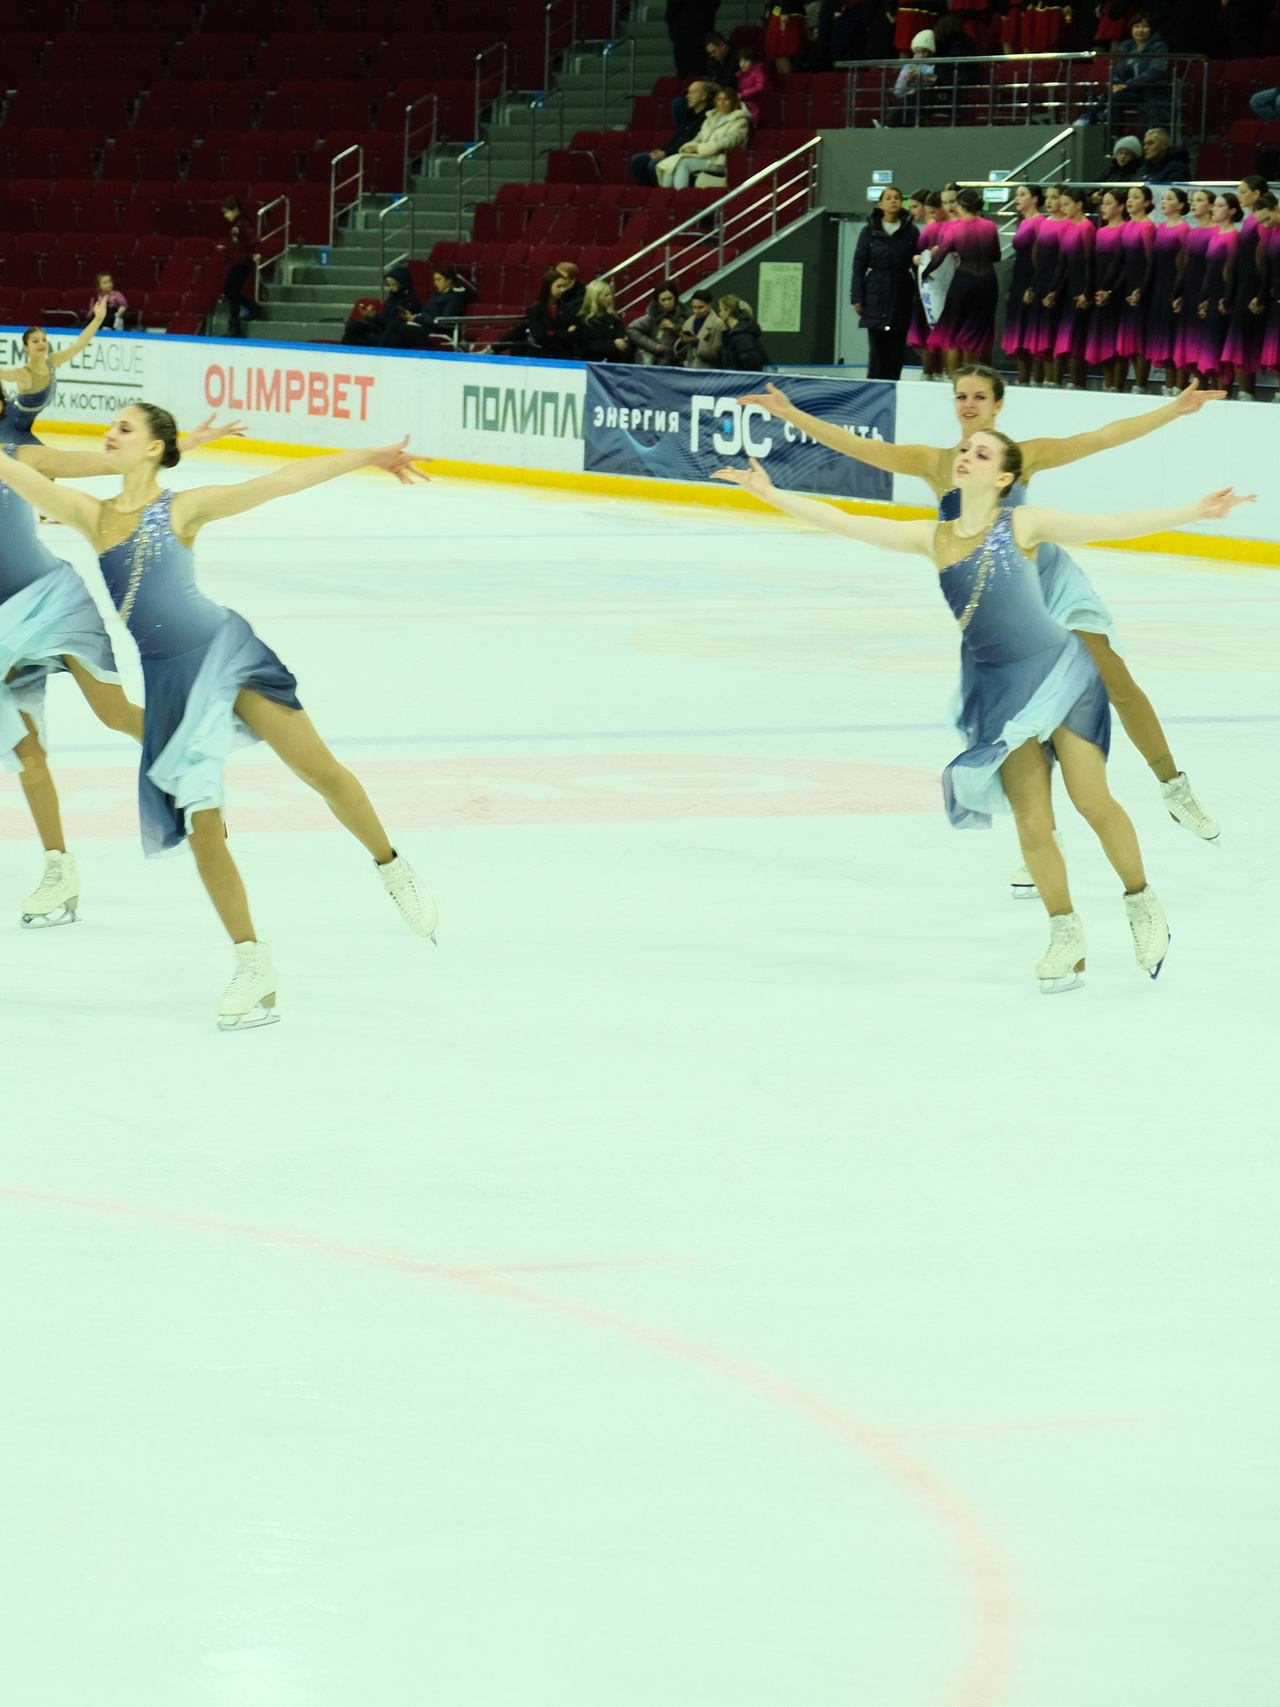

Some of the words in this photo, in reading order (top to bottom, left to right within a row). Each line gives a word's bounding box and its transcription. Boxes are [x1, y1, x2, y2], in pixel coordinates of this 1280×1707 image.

[204, 364, 374, 421] OLIMPBET
[463, 385, 586, 440] ПОЛИПЛ
[593, 405, 680, 433] ЭНЕРГИЯ
[690, 395, 772, 458] ГЭС
